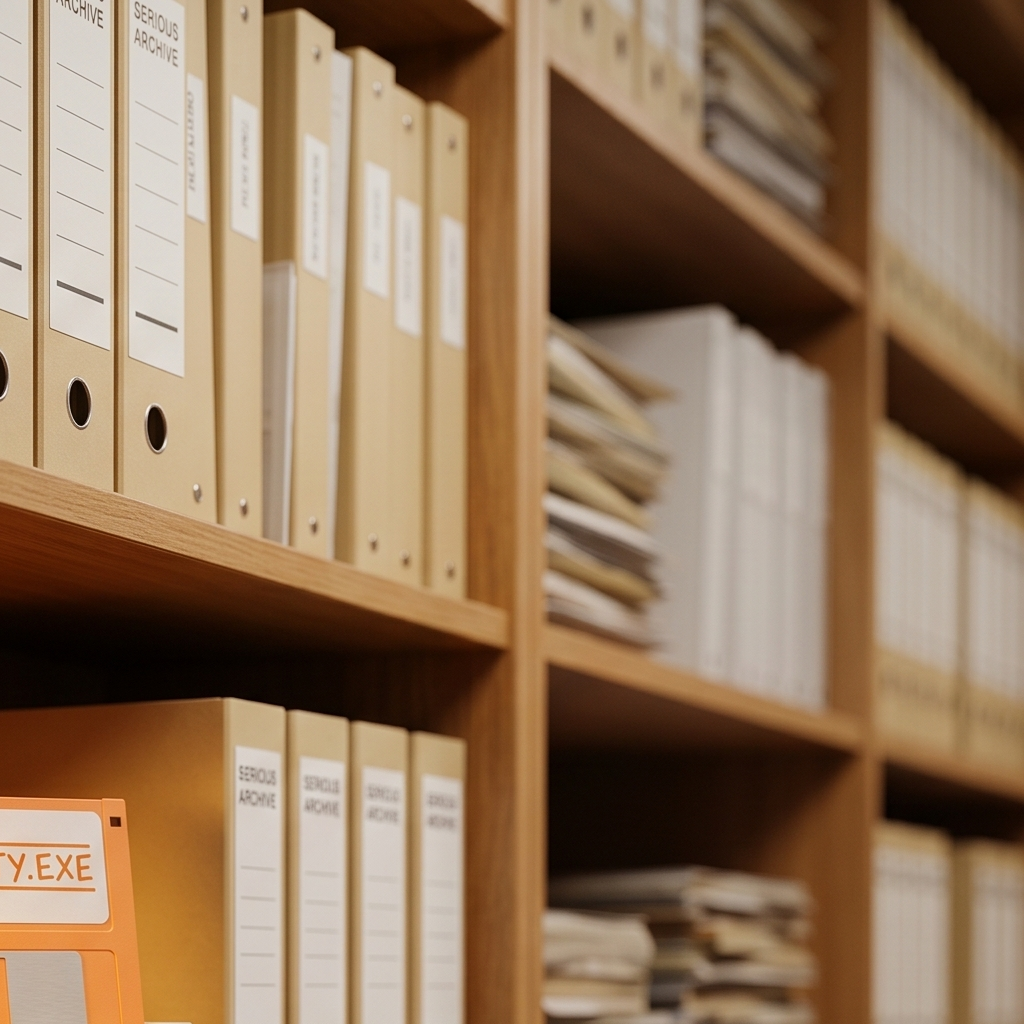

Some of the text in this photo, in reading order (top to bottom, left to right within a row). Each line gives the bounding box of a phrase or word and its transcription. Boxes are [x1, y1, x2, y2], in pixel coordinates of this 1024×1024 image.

[134, 1, 179, 42] SERIOUS
[134, 28, 179, 68] ARCHIVE
[238, 765, 277, 786] SERIOUS
[238, 789, 277, 810] ARCHIVE
